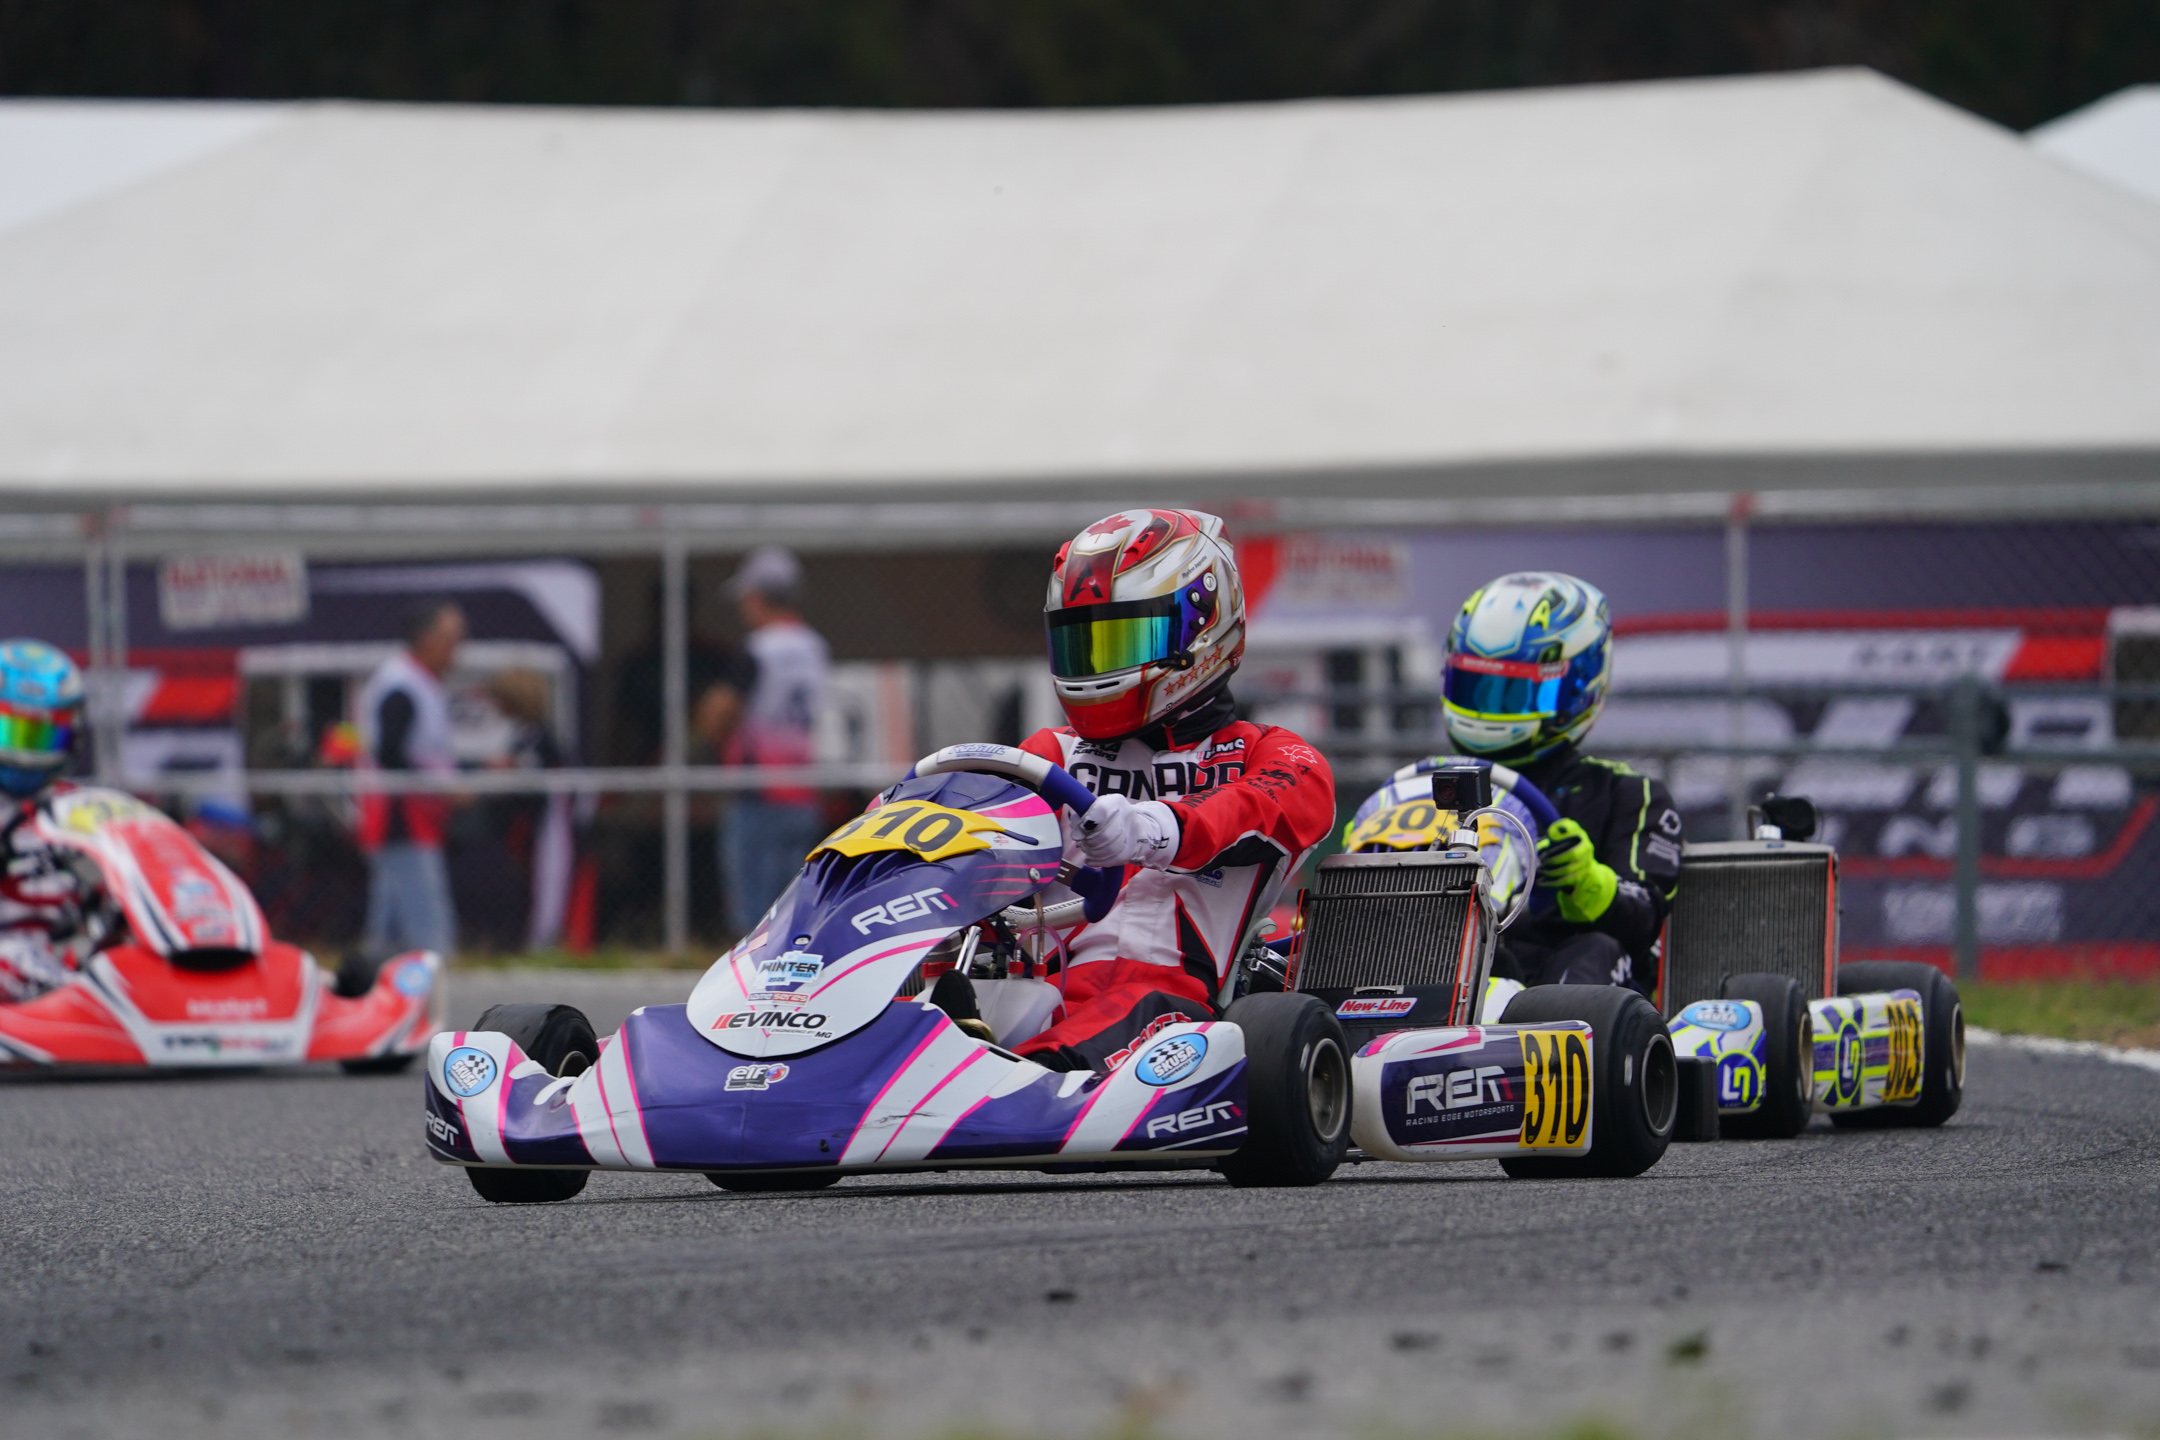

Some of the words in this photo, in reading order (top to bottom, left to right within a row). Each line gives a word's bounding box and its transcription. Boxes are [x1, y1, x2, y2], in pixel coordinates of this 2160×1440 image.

[820, 806, 964, 852] 310
[760, 962, 820, 974] WINTER
[1340, 1000, 1411, 1011] New-Line
[728, 1012, 827, 1029] EVINCO
[1153, 1044, 1198, 1078] SKUSA
[451, 1060, 480, 1090] SKUSA
[731, 1067, 767, 1079] elf
[1524, 1033, 1590, 1144] 310
[1406, 1115, 1438, 1127] RACING
[1441, 1112, 1462, 1122] EDGE
[1464, 1104, 1515, 1119] MOTORSPORTS
